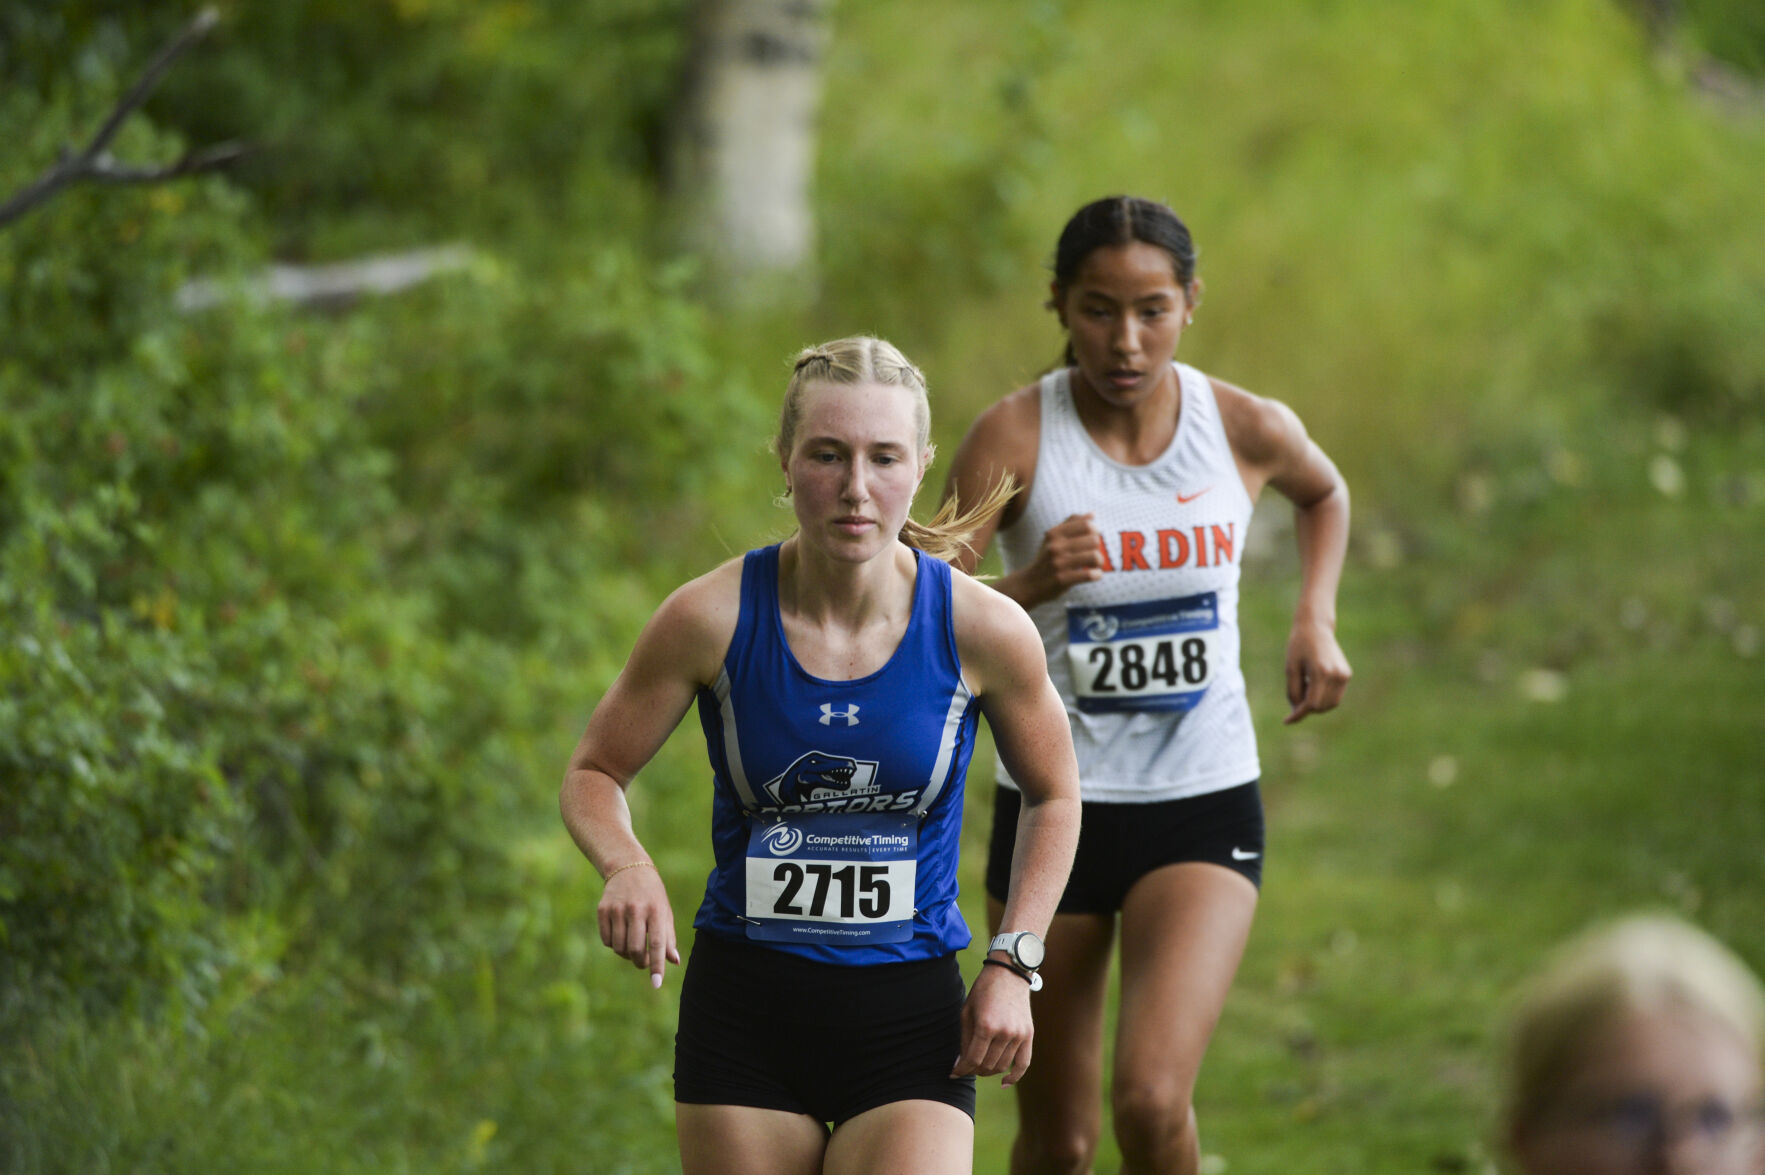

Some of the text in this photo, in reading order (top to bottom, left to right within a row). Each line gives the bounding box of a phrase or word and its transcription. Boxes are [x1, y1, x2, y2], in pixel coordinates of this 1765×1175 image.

[1089, 637, 1208, 693] 2848
[813, 785, 880, 800] GALLATIN
[773, 862, 891, 919] 2715
